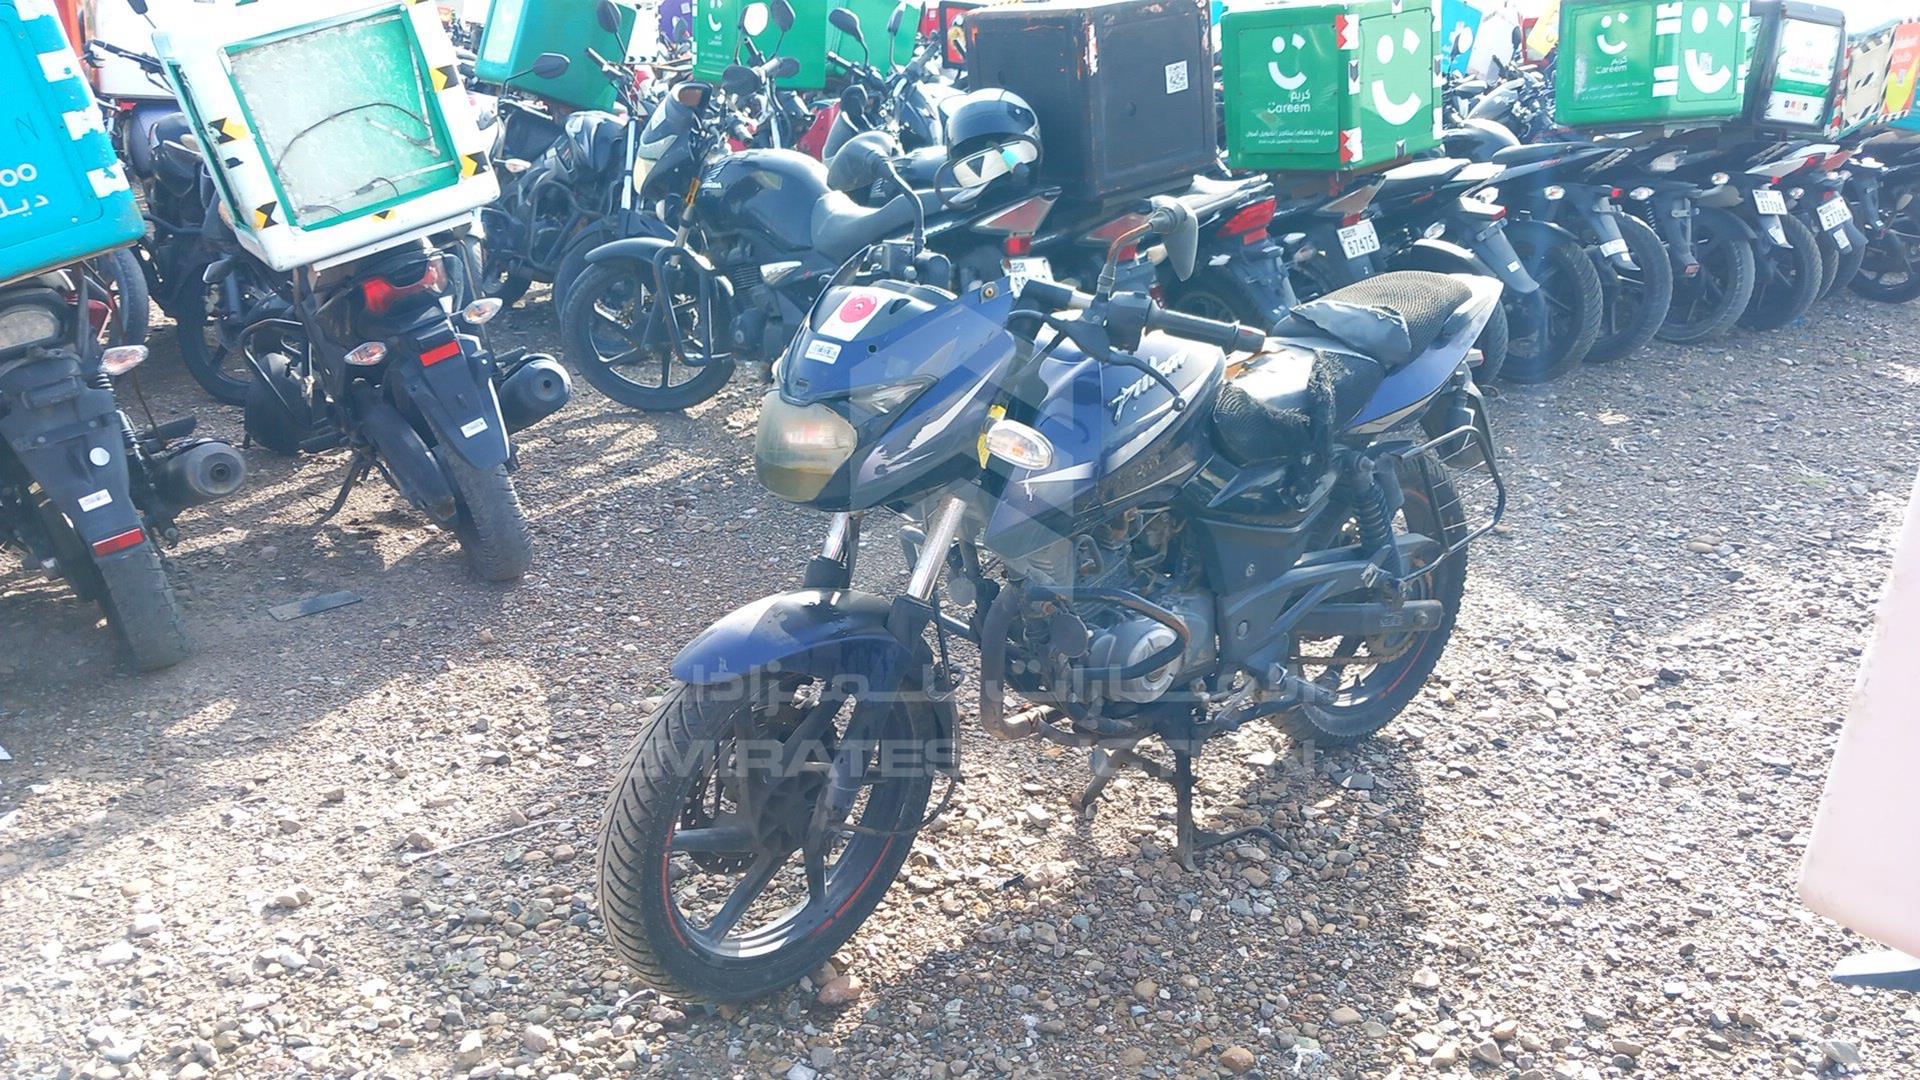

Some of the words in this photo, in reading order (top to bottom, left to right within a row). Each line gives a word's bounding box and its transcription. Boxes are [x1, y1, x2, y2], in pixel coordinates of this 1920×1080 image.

[1290, 89, 1311, 102] كريم
[1267, 102, 1311, 114] Careem
[1347, 234, 1376, 256] 67475
